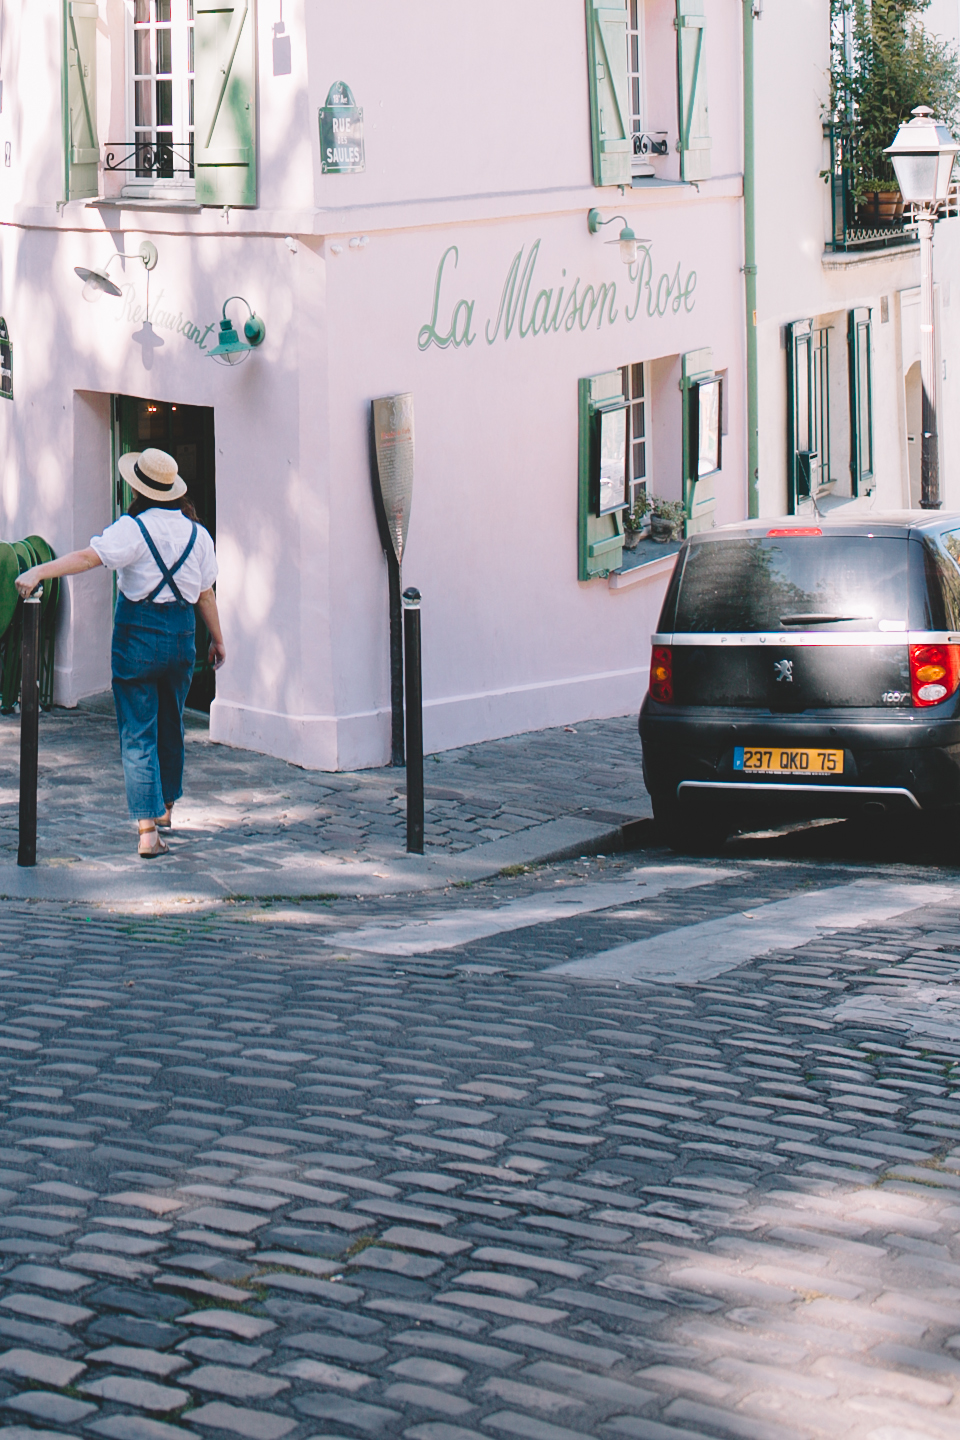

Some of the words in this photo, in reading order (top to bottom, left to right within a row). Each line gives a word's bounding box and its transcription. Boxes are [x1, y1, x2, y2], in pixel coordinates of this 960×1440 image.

[333, 117, 351, 133] RUE
[337, 136, 348, 145] DES
[327, 147, 360, 163] SAULES
[417, 245, 477, 351] La
[485, 238, 619, 345] Maison
[625, 243, 697, 323] Rose
[115, 282, 216, 350] Restaurant
[881, 692, 907, 703] 1007
[743, 750, 773, 769] 237
[780, 751, 809, 770] QKD
[817, 752, 837, 771] 75
